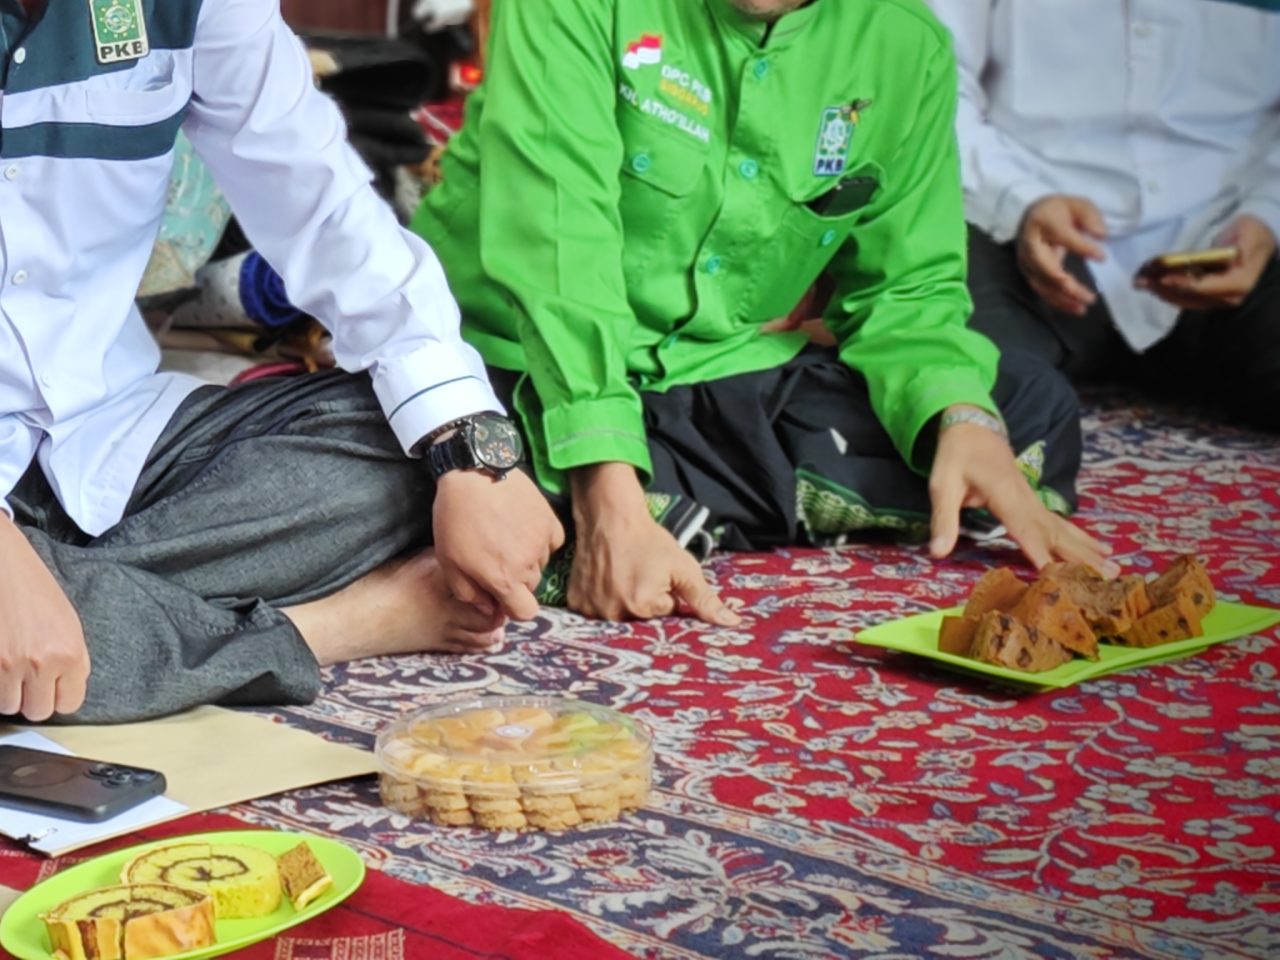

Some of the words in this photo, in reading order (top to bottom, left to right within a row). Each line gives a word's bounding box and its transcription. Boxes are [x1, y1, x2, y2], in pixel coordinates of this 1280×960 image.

[100, 41, 143, 59] PKB
[662, 64, 690, 87] DPC
[817, 158, 844, 172] PKB
